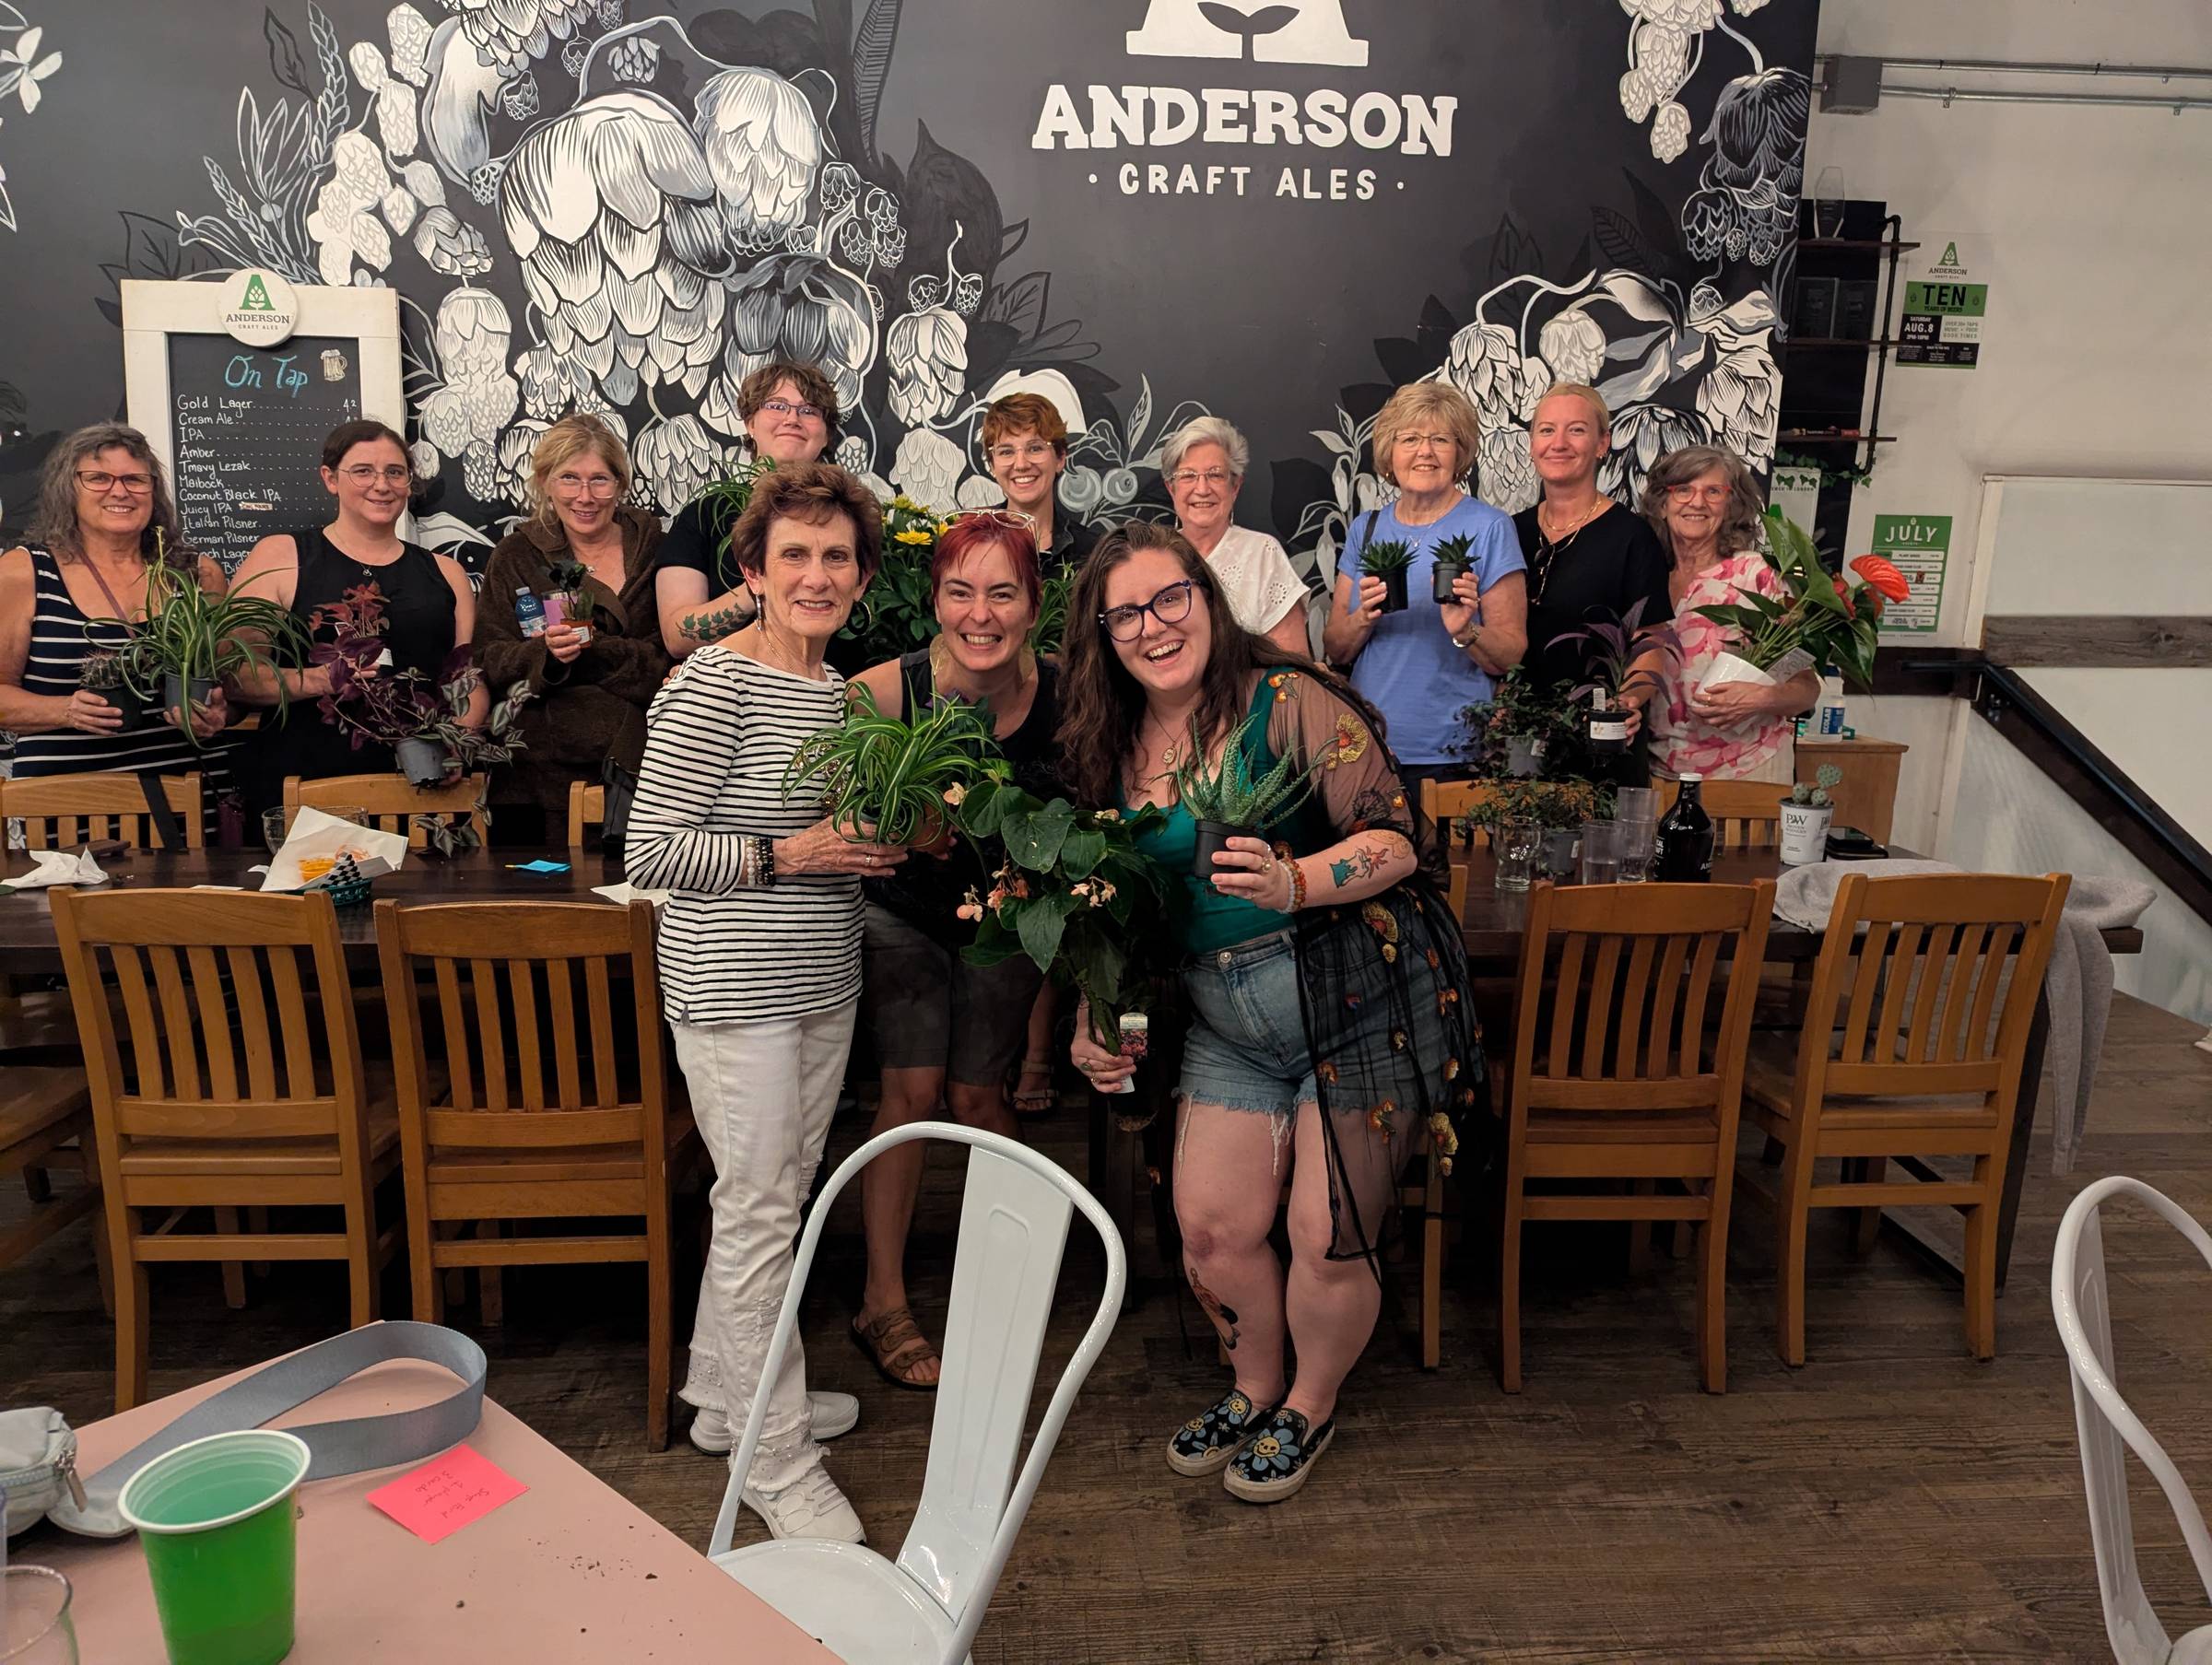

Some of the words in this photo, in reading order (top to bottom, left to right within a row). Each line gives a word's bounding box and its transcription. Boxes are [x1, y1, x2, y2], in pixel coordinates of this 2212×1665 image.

[1031, 84, 1458, 157] ANDERSON
[1119, 163, 1251, 196] CRAFT
[1276, 168, 1376, 200] ALES
[1928, 267, 1967, 276] ANDERSON
[1923, 284, 1966, 306] TEN
[226, 313, 290, 324] ANDERSON
[224, 355, 263, 390] On
[272, 355, 308, 399] Tap
[177, 394, 209, 411] Gold
[219, 397, 253, 418] Lager
[178, 412, 214, 427] Cream
[216, 412, 234, 426] Ale
[179, 427, 206, 443] IPA
[179, 444, 216, 460] Amber
[178, 460, 216, 480] Tmavy
[218, 461, 253, 472] Lezak
[178, 475, 225, 489] Maibock
[179, 488, 223, 501] Coconut
[222, 488, 258, 501] Black
[262, 488, 282, 501] IPA
[180, 502, 210, 522] Juicy
[213, 503, 233, 513] IPA
[182, 515, 220, 530] Italian
[222, 516, 259, 528] Pilsner
[181, 530, 224, 545] German
[225, 531, 260, 544] Pilsner
[1884, 525, 1938, 543] JULY
[222, 548, 252, 564] Lager
[1822, 708, 1831, 733] ECOLAB
